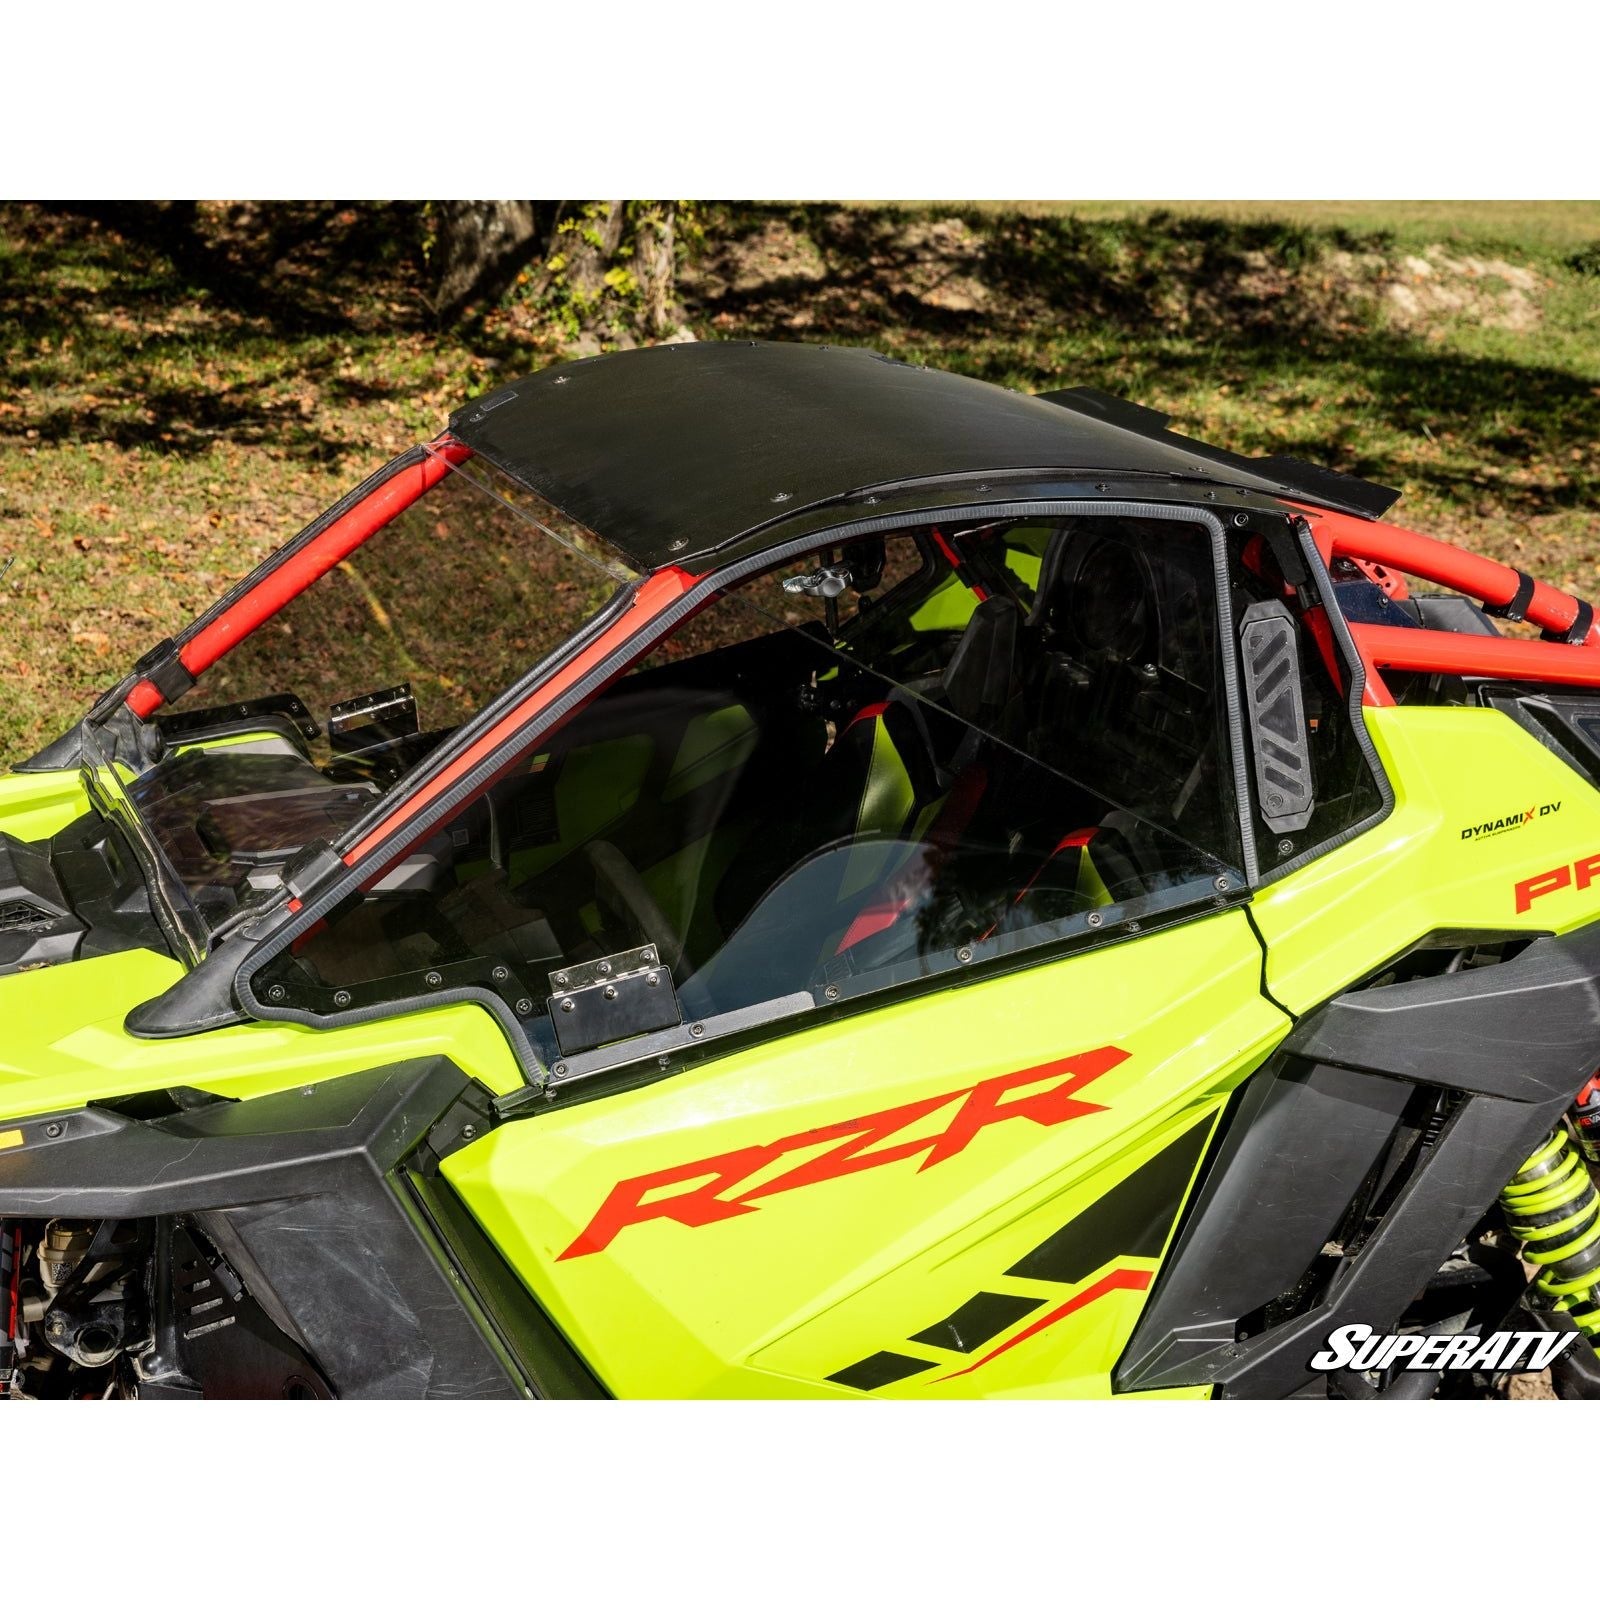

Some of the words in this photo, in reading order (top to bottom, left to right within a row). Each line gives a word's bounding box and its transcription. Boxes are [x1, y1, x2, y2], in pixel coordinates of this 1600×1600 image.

[1461, 806, 1535, 840] DYNAMIX
[1540, 801, 1561, 816] DV
[554, 1045, 1133, 1262] RZR
